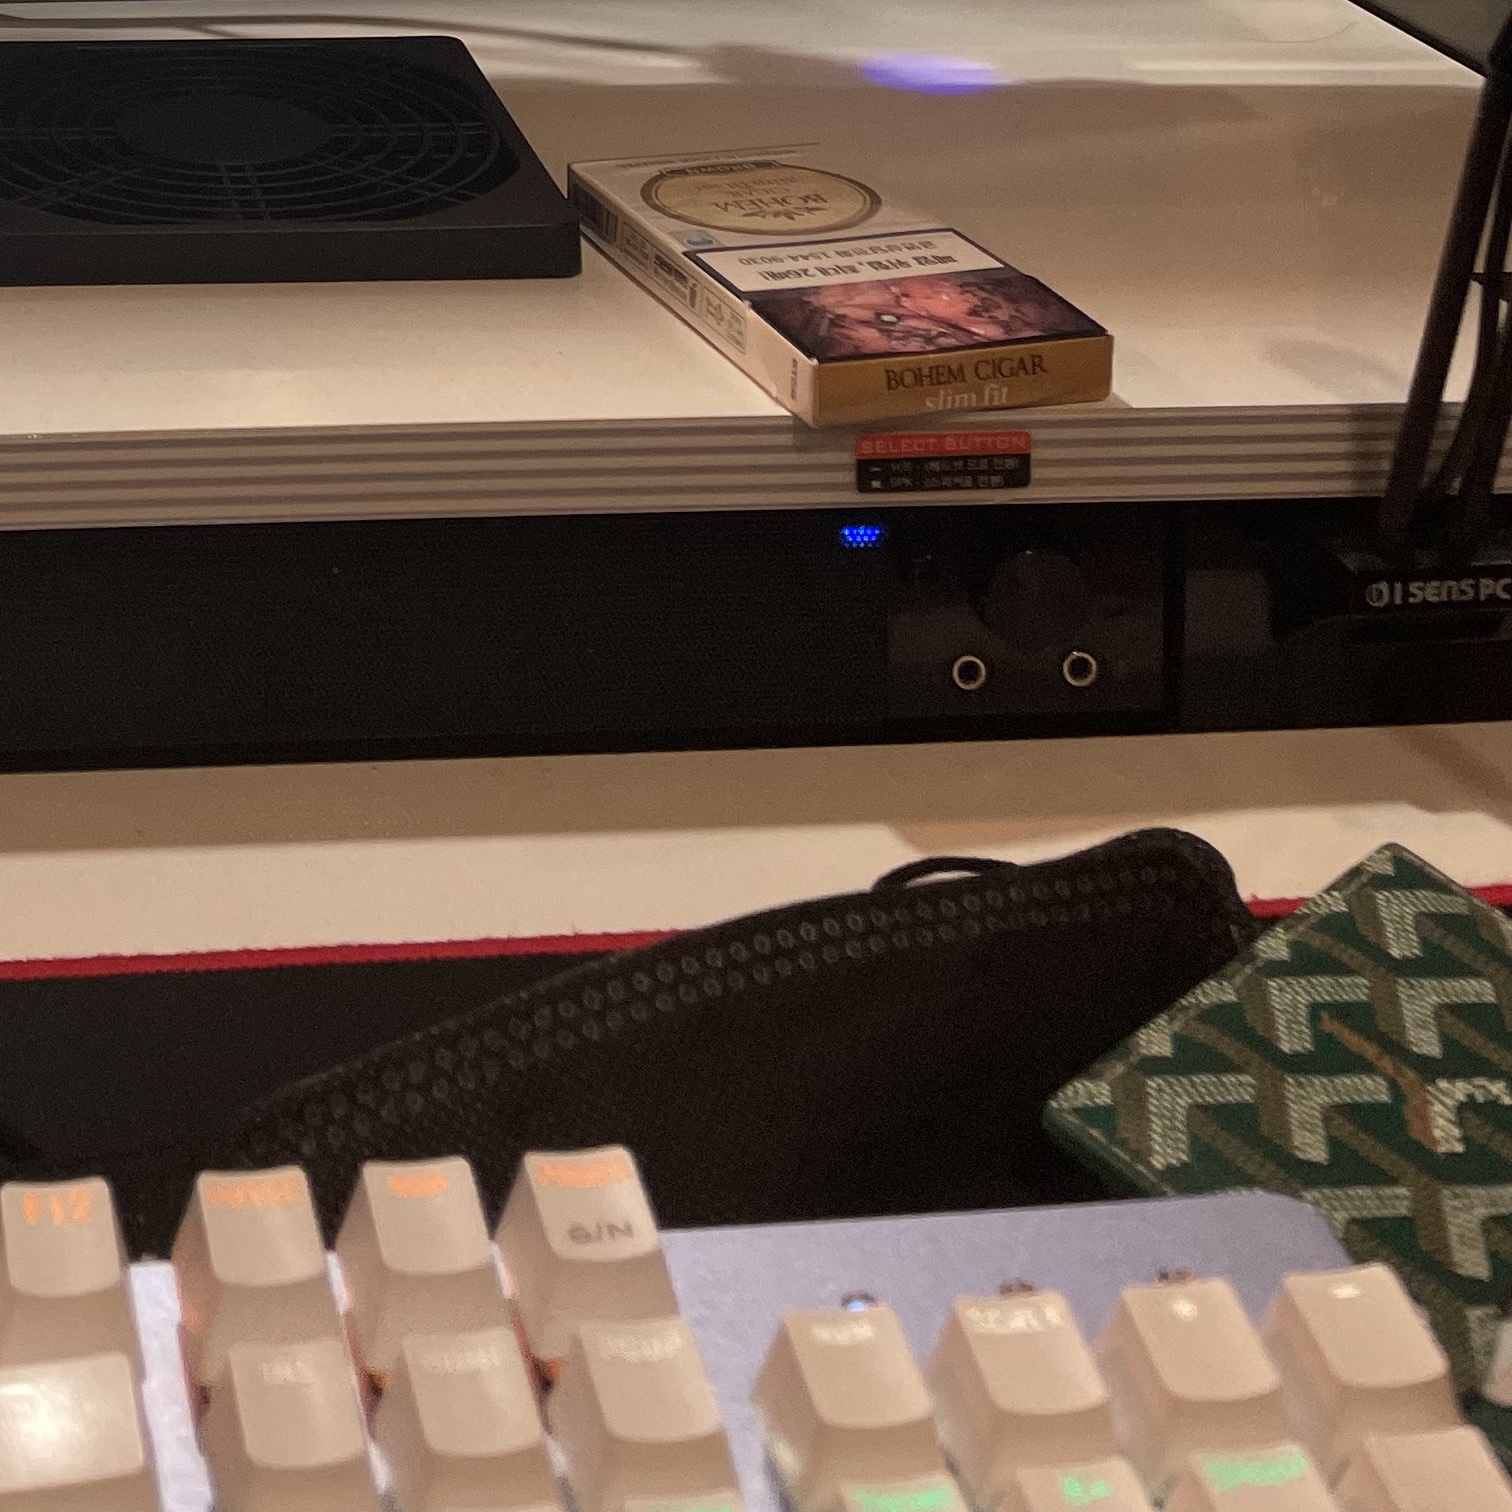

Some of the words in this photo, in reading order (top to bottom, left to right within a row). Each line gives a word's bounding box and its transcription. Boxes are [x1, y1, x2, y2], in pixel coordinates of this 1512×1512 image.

[885, 362, 968, 390] BOHEM
[973, 354, 1049, 382] CIGAR
[861, 438, 939, 454] SELECT
[944, 436, 1026, 451] BUTTON
